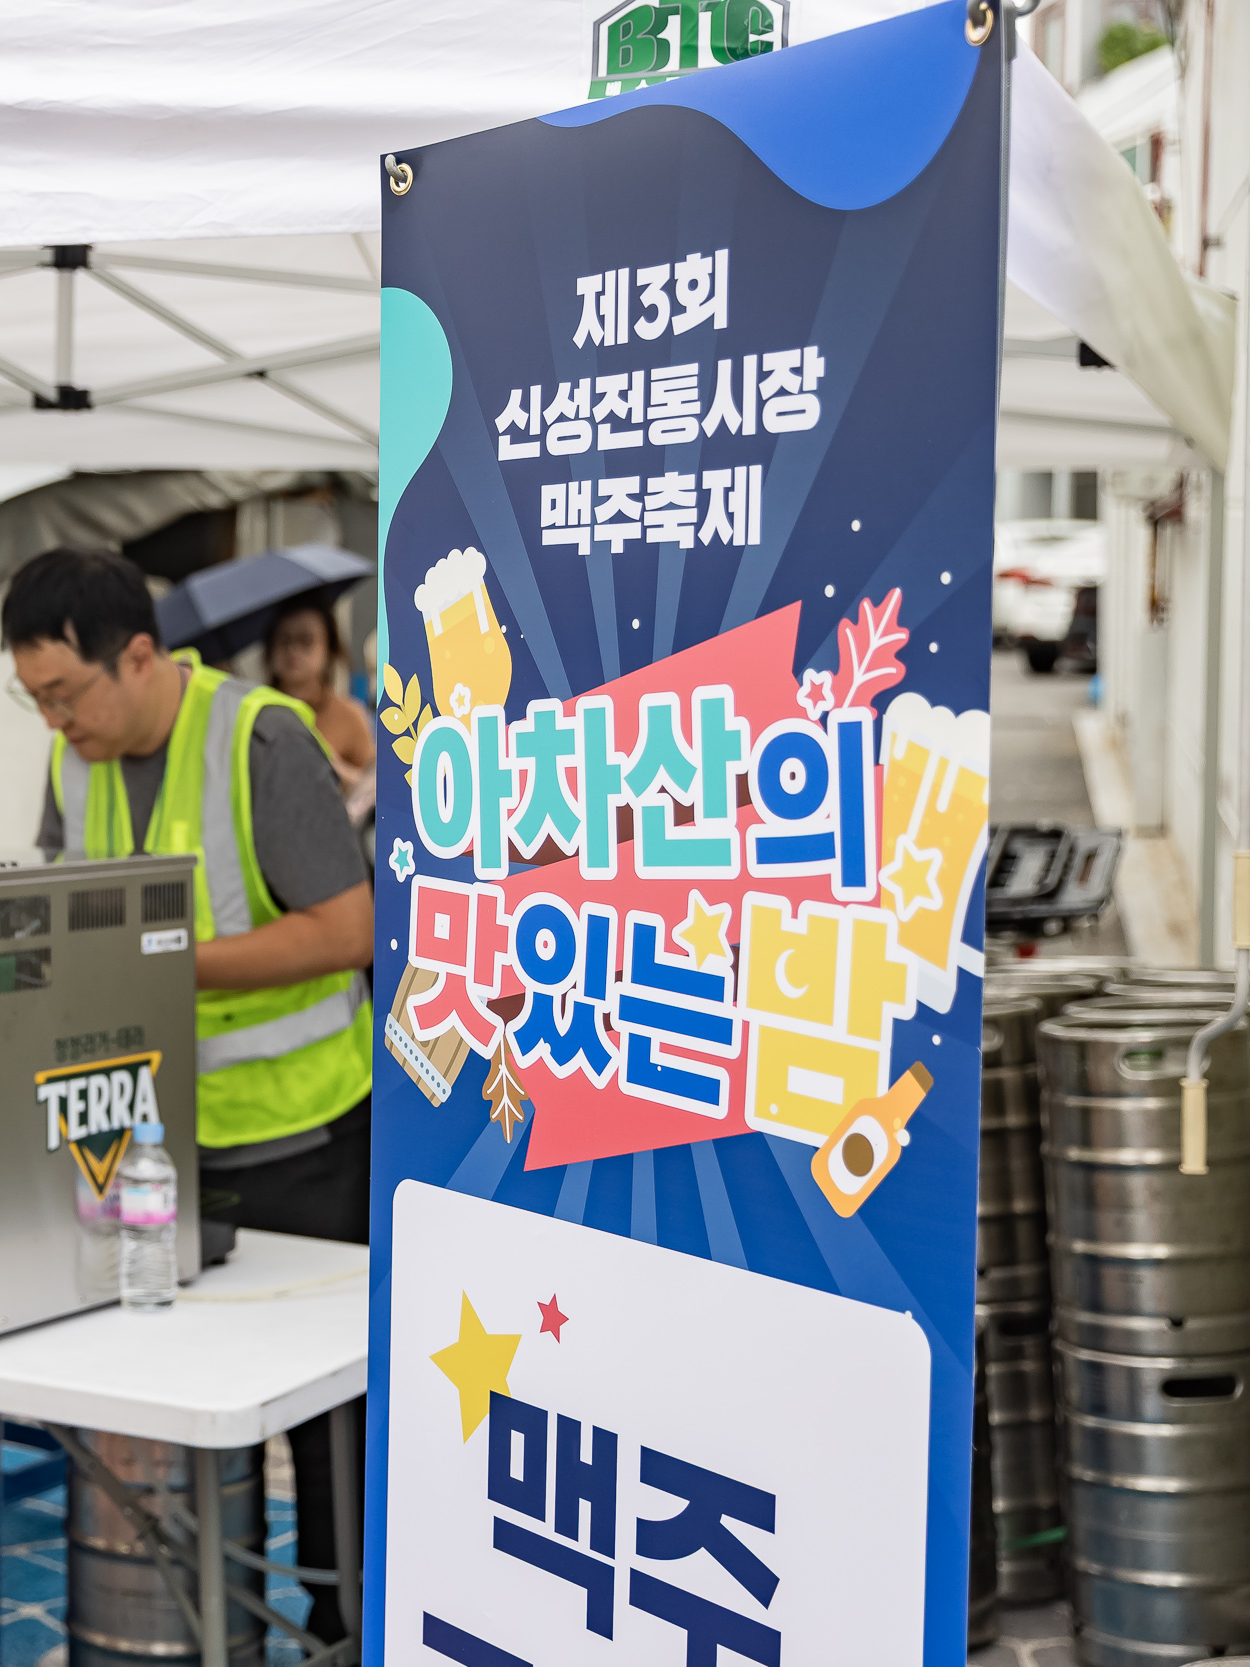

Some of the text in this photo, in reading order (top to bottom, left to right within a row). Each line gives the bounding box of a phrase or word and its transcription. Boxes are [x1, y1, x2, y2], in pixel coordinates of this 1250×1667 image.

[607, 0, 774, 74] BTC
[573, 249, 729, 349] 제3회
[494, 346, 825, 461] 신성전통시장
[540, 465, 763, 556] 맥주축제
[412, 686, 875, 900] 아차산의
[408, 876, 915, 1147] 맛있는 밤
[37, 1064, 160, 1151] TERRA
